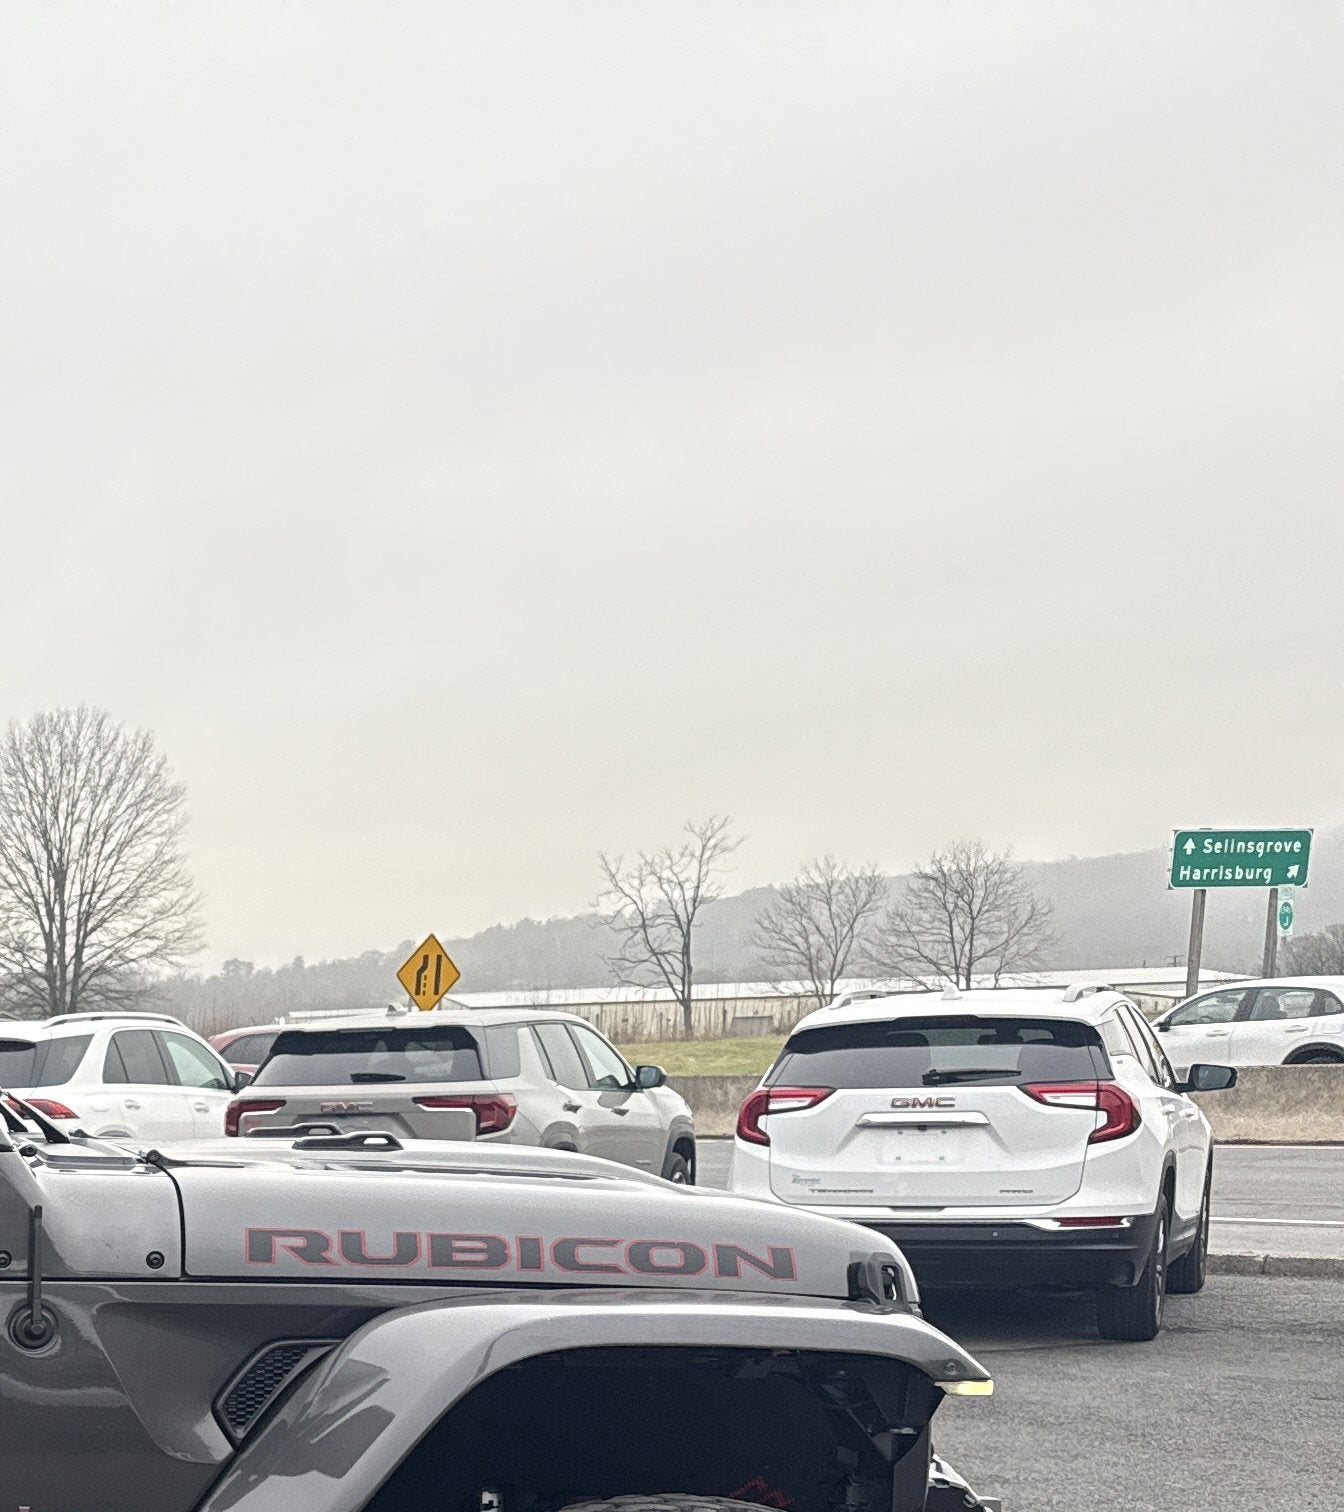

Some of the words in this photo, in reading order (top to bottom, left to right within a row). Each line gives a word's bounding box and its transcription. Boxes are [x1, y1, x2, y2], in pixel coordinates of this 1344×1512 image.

[1202, 838, 1302, 858] Selinsgrove
[1179, 865, 1273, 885] Harrisburg
[890, 1096, 956, 1109] GMC
[244, 1227, 799, 1282] RUBICON
